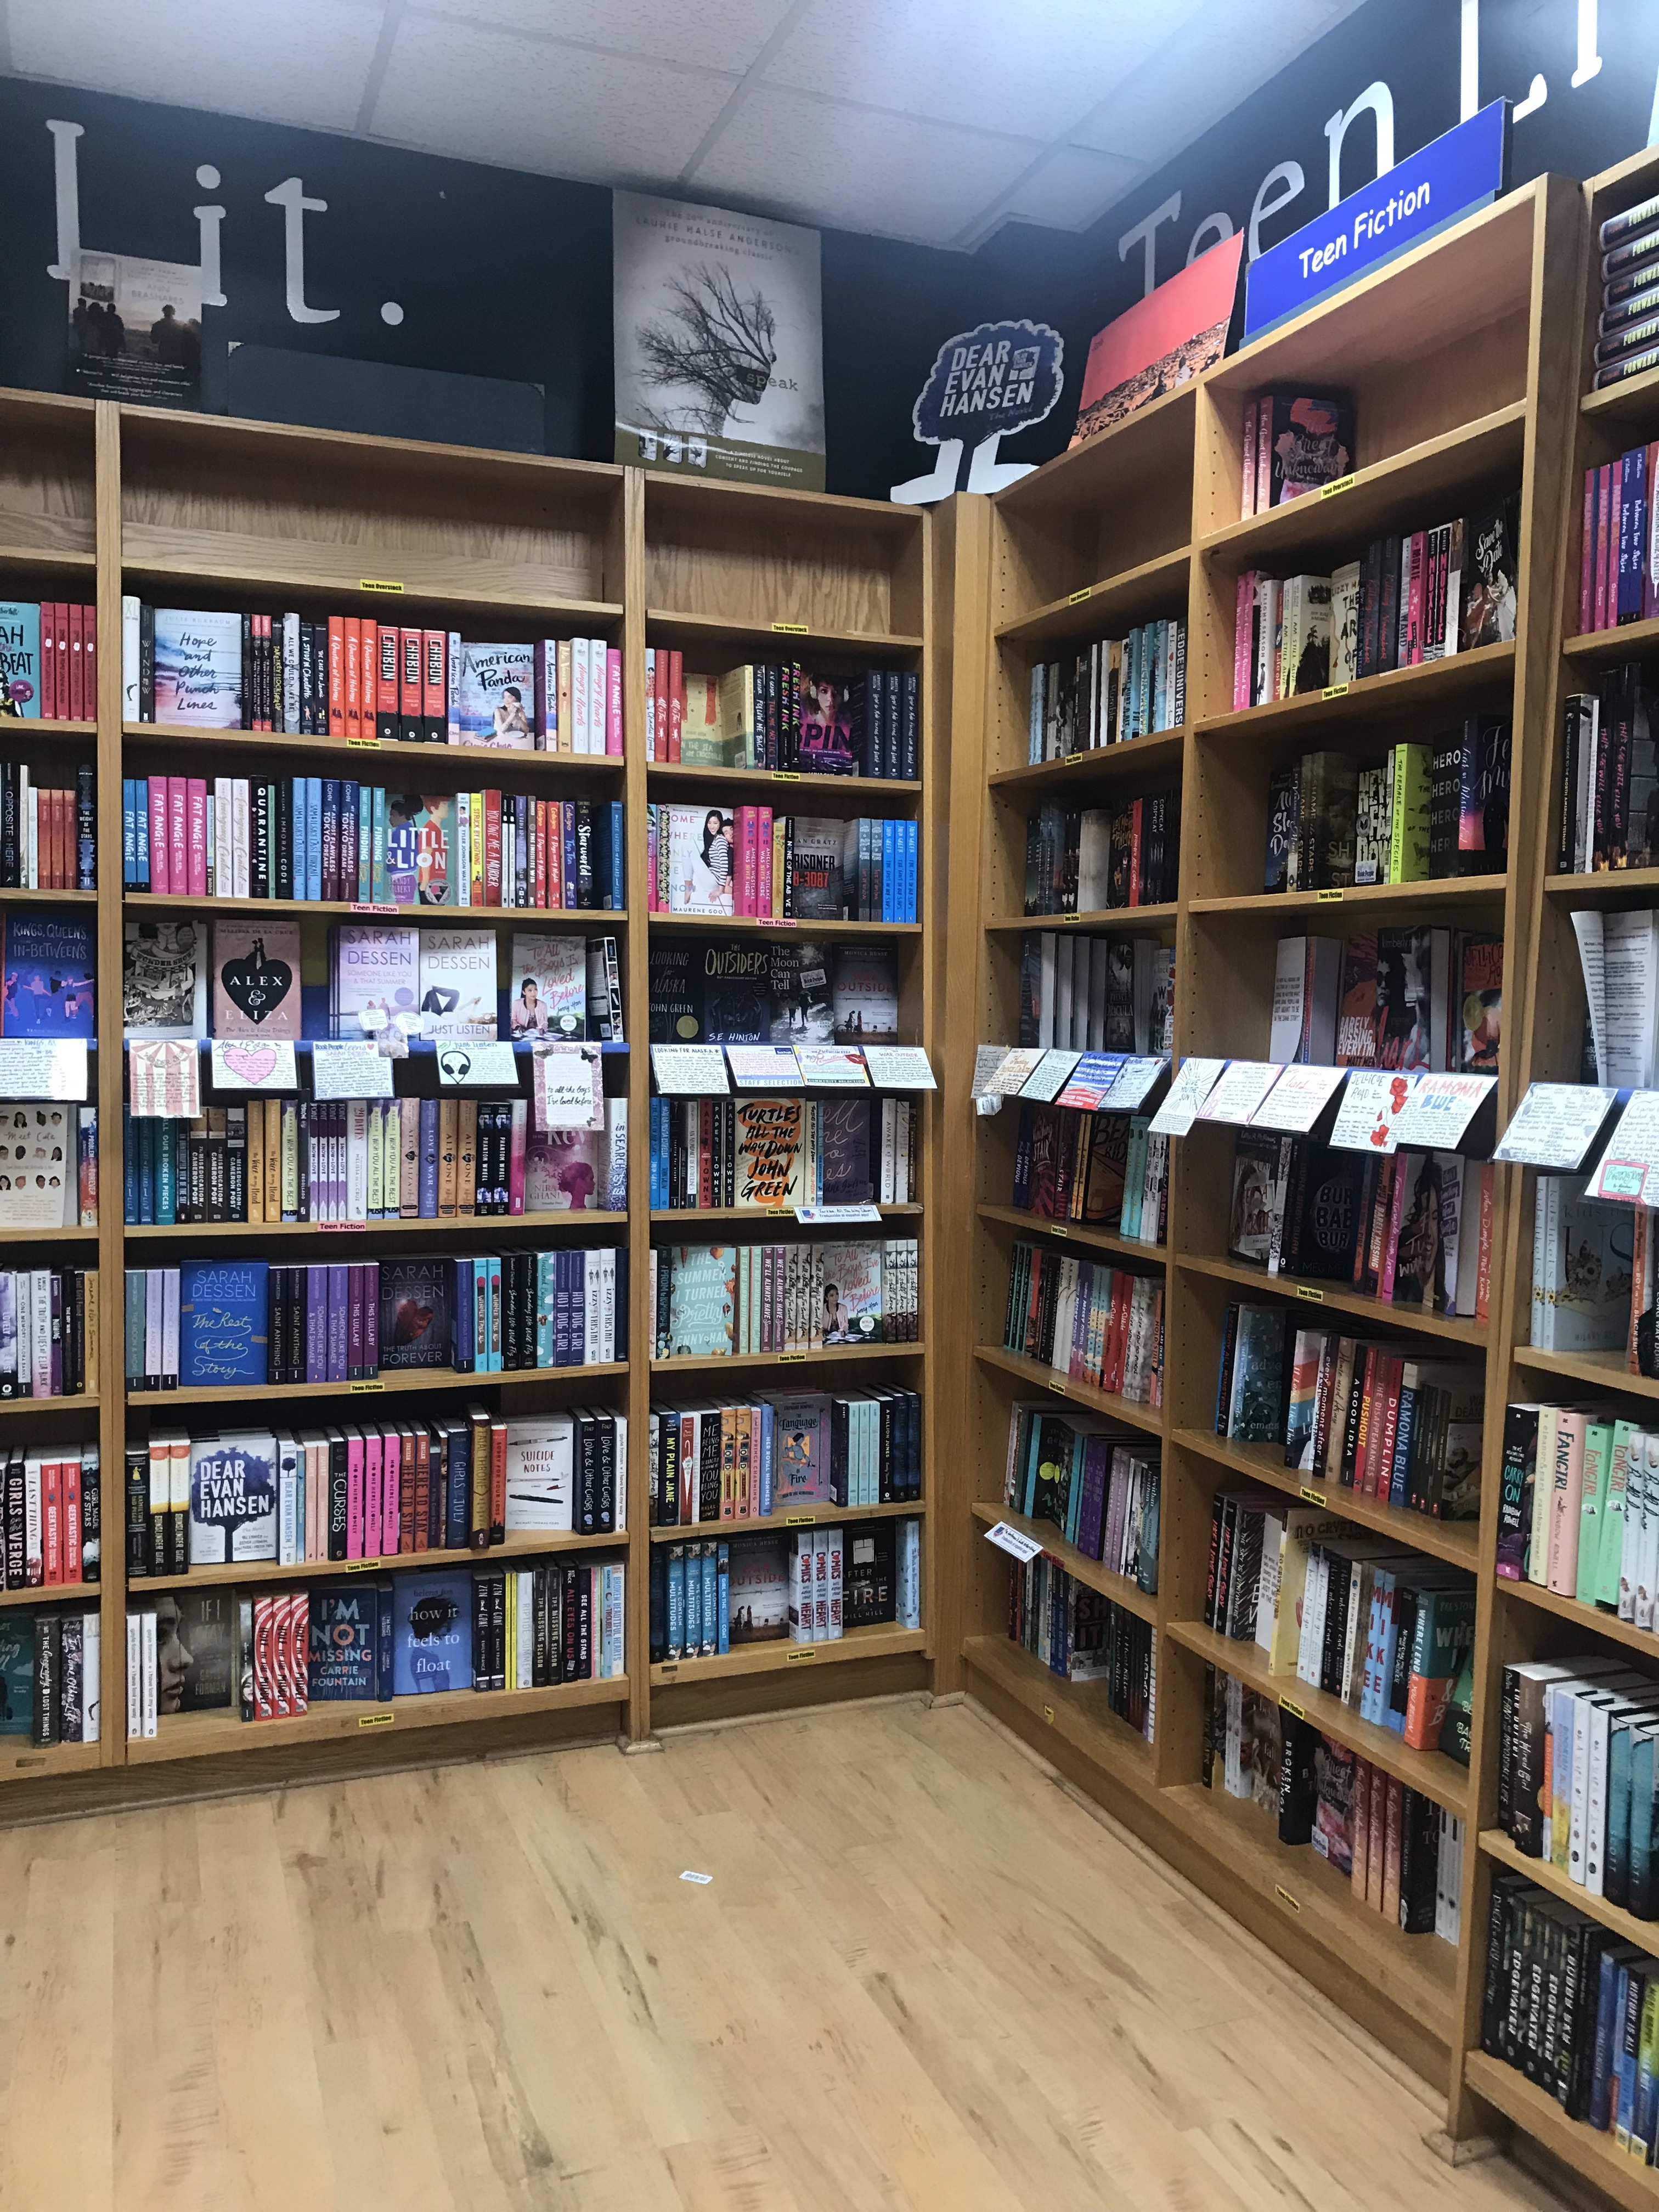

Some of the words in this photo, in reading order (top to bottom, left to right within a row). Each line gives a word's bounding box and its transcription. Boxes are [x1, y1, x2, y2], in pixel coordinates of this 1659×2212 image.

[1118, 81, 1395, 297] Teen
[46, 119, 404, 324] Lit.
[636, 217, 678, 232] LAURIE
[686, 225, 722, 239] HALSE
[1299, 233, 1348, 279] Teen
[1353, 180, 1431, 252] Fiction
[665, 235, 740, 255] groundbreaking
[742, 249, 773, 261] classic
[952, 341, 1012, 371] DEAR
[746, 371, 799, 393] speak
[945, 367, 1006, 395] EVAN
[940, 381, 1034, 417] HANSEN
[376, 584, 402, 592] Overstock
[180, 632, 218, 648] Hope
[184, 648, 211, 662] and
[381, 635, 395, 681] CHABON
[462, 650, 531, 676] American
[178, 665, 218, 679] Other
[176, 681, 218, 695] Punch
[476, 673, 525, 691] Panda
[177, 698, 218, 710] Lines
[1433, 749, 1461, 769] HERO
[257, 787, 267, 880] QUARANTINE
[388, 828, 450, 850] LITTLE
[386, 855, 396, 864] &
[397, 851, 446, 870] LION
[13, 922, 44, 937] KINGS,
[46, 924, 89, 940] QUEENS,
[347, 930, 411, 945] SARAH
[428, 936, 489, 950] SARAH
[771, 946, 789, 956] The
[14, 943, 87, 960] IN-BETWEENS
[348, 951, 412, 965] DESSEN
[428, 956, 490, 969] DESSEN
[705, 949, 768, 975] OUTSIDERS
[771, 957, 799, 967] Moon
[230, 975, 284, 986] ALEX
[771, 969, 791, 979] Can
[771, 980, 789, 990] Tell
[248, 990, 266, 1006] &
[225, 1011, 288, 1020] ELIZA
[429, 1025, 451, 1035] JUST
[454, 1025, 490, 1034] LISTEN
[709, 1033, 725, 1041] S.E.
[729, 1032, 760, 1042] HINTON
[1351, 1071, 1384, 1086] JELLICOE
[548, 1086, 554, 1094] to
[576, 1086, 590, 1096] boys
[1352, 1087, 1370, 1099] ROAD
[1418, 1079, 1483, 1098] RAMONA
[560, 1096, 573, 1105] loved
[575, 1096, 592, 1106] before
[1420, 1095, 1455, 1111] BLUE
[737, 1103, 802, 1124] TURTLES
[746, 1125, 770, 1139] ALL
[772, 1126, 796, 1139] THE
[738, 1141, 766, 1155] WAY
[767, 1141, 802, 1157] DOWN
[747, 1161, 791, 1178] JOHN
[740, 1178, 796, 1199] GREEN
[691, 1253, 709, 1265] THE
[196, 1271, 252, 1284] SARAH
[382, 1265, 444, 1280] SARAH
[676, 1271, 725, 1285] SUMMER
[192, 1284, 256, 1297] DESSEN
[382, 1284, 444, 1300] DESSEN
[676, 1290, 680, 1302] I
[684, 1285, 727, 1301] TURNED
[193, 1312, 215, 1329] The
[215, 1314, 252, 1329] Rest
[674, 1303, 724, 1327] Pretty
[217, 1339, 248, 1352] the
[673, 1333, 705, 1348] JENNY
[709, 1331, 729, 1342] HAN
[383, 1351, 442, 1364] FOREVER
[192, 1358, 255, 1379] Story
[1396, 1389, 1414, 1453] RAMONA
[667, 1437, 675, 1449] MY
[1380, 1397, 1397, 1485] DUMPLIN'
[521, 1449, 555, 1462] SUICIDE
[1555, 1430, 1575, 1493] FANGIRL
[200, 1461, 245, 1480] DEAR
[523, 1463, 551, 1474] NOTES
[666, 1452, 675, 1477] PLAIN
[1392, 1454, 1406, 1492] BLUE
[1504, 1465, 1524, 1483] CARRY
[200, 1480, 244, 1499] EVAN
[665, 1479, 674, 1503] JANE
[1504, 1485, 1521, 1503] ON
[200, 1494, 269, 1518] HANSEN
[332, 1478, 346, 1533] CURSES
[361, 1561, 379, 1570] Fiction
[321, 1598, 359, 1622] I'M
[409, 1606, 443, 1621] how
[447, 1606, 459, 1618] it
[312, 1623, 370, 1646] NOT
[408, 1632, 441, 1648] feels
[445, 1633, 460, 1645] to
[309, 1649, 372, 1662] MISSING
[320, 1665, 359, 1675] CARRIE
[416, 1657, 452, 1674] float
[312, 1675, 366, 1687] FOUNTAIN
[375, 1714, 392, 1723] Fiction
